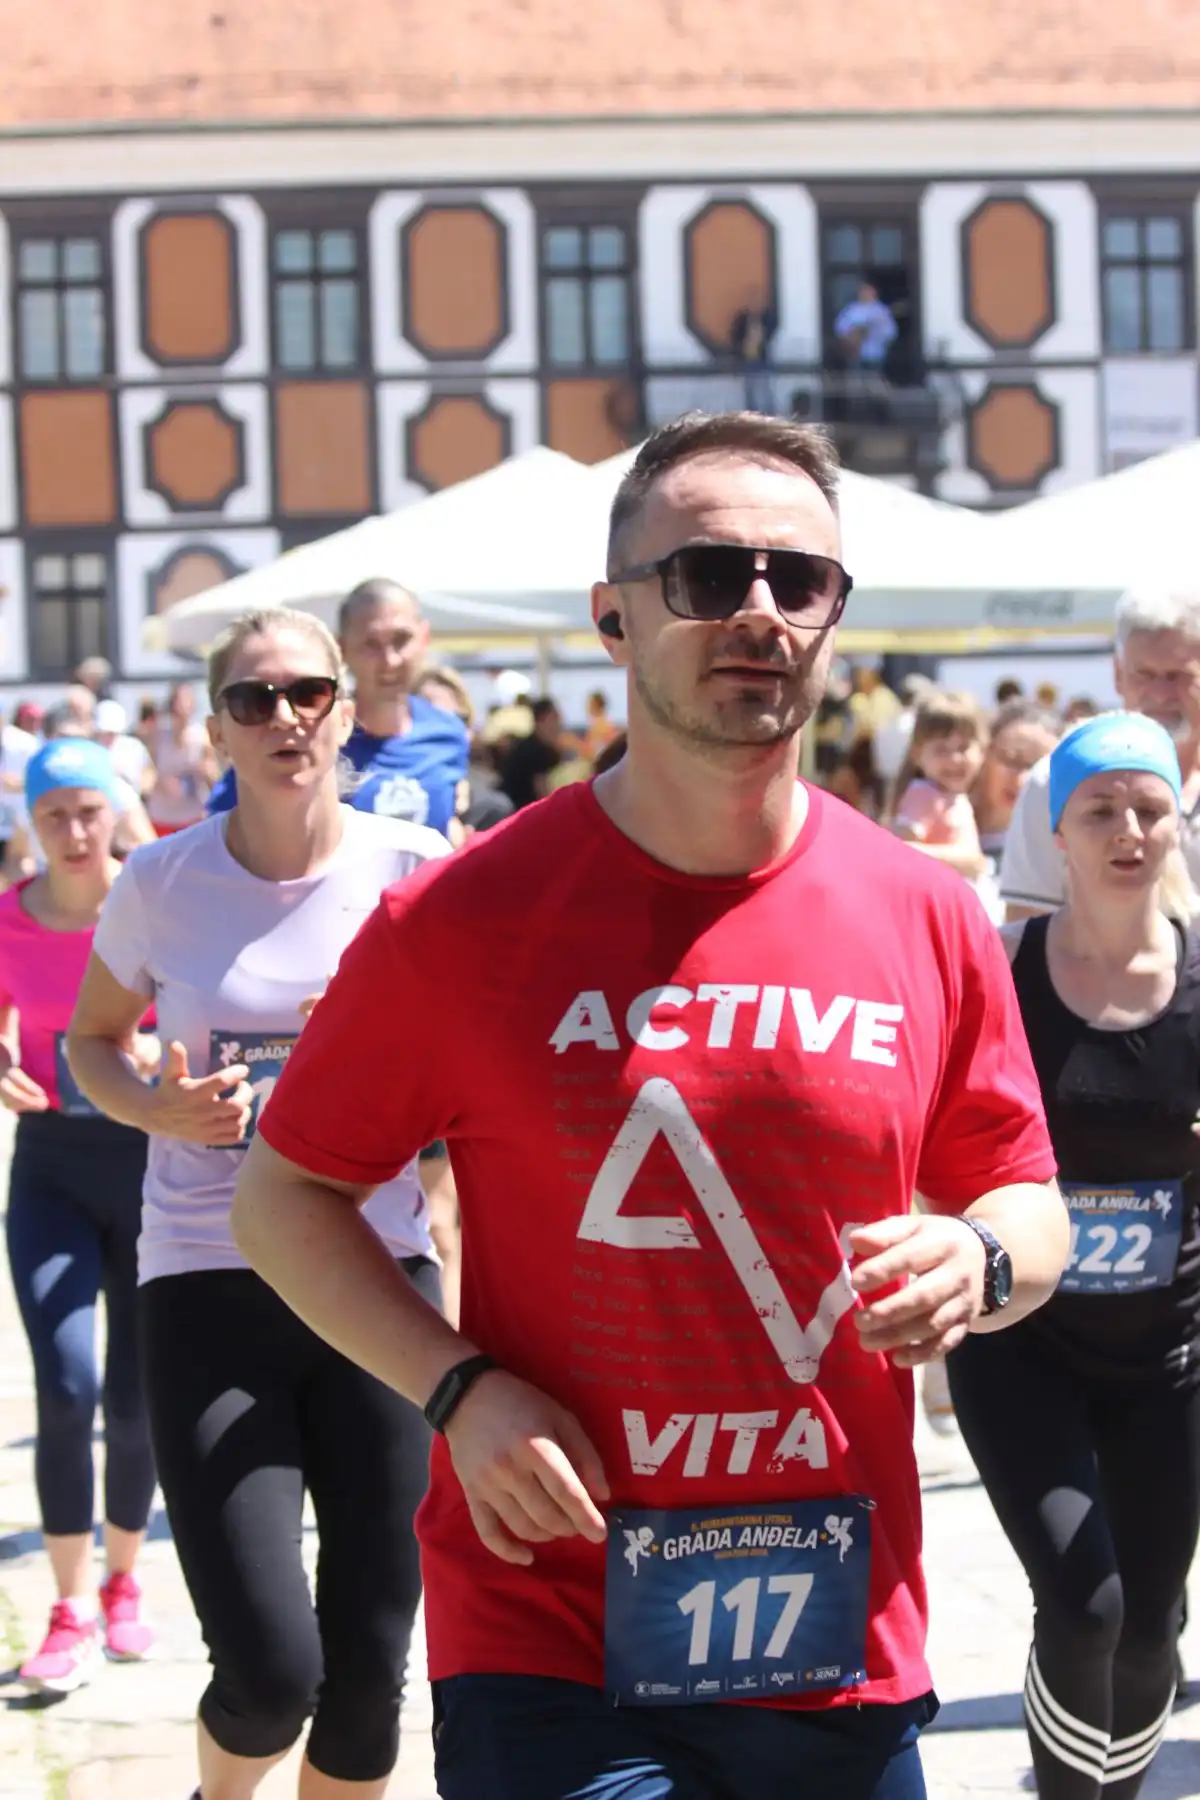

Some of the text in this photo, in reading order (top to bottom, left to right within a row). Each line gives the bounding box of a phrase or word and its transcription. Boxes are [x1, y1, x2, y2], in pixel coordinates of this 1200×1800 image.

[548, 984, 904, 1067] ACTIVE
[622, 1408, 829, 1477] VITA
[663, 1527, 732, 1561] GRADA
[677, 1573, 814, 1665] 117
